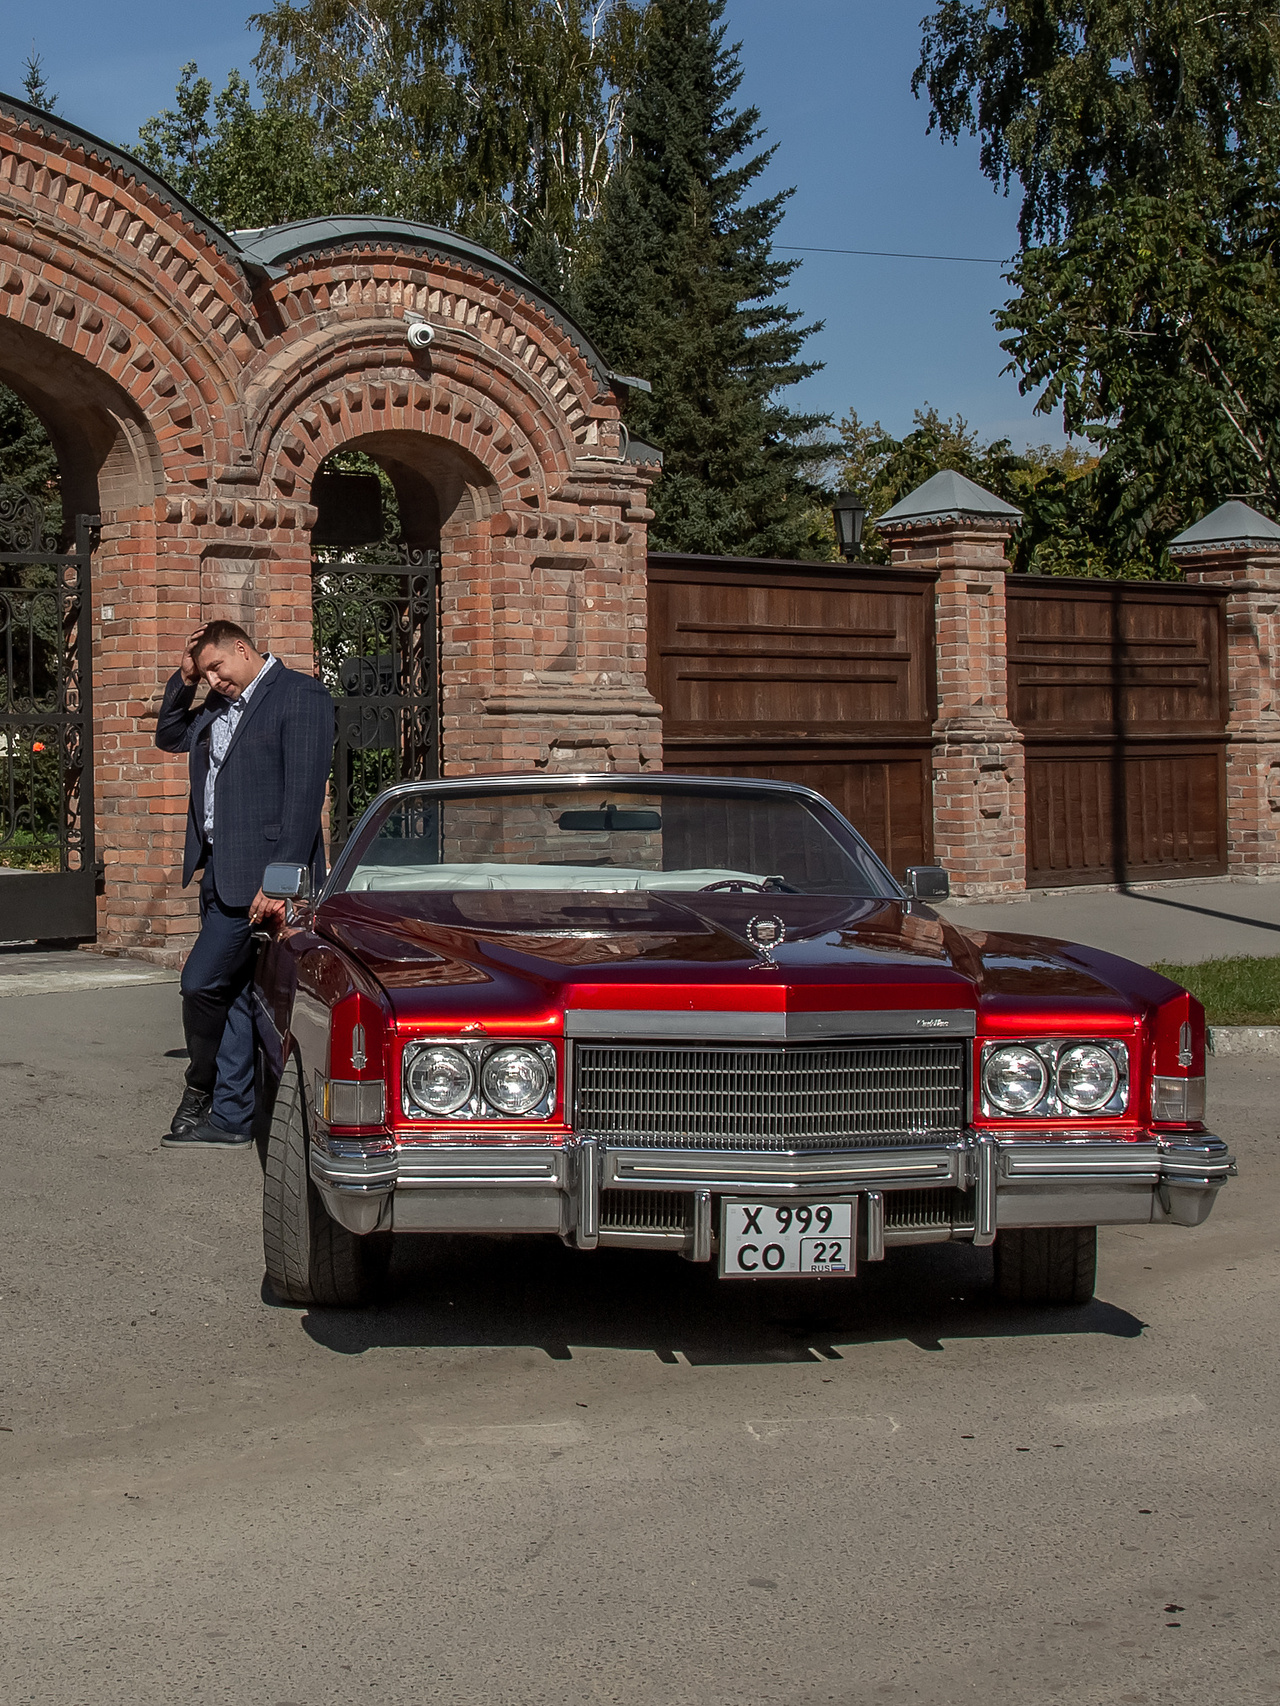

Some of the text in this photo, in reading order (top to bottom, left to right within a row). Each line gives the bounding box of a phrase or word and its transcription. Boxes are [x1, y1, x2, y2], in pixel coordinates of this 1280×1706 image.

[775, 1206, 833, 1234] 999
[813, 1241, 842, 1263] 22
[810, 1264, 831, 1273] RUS
